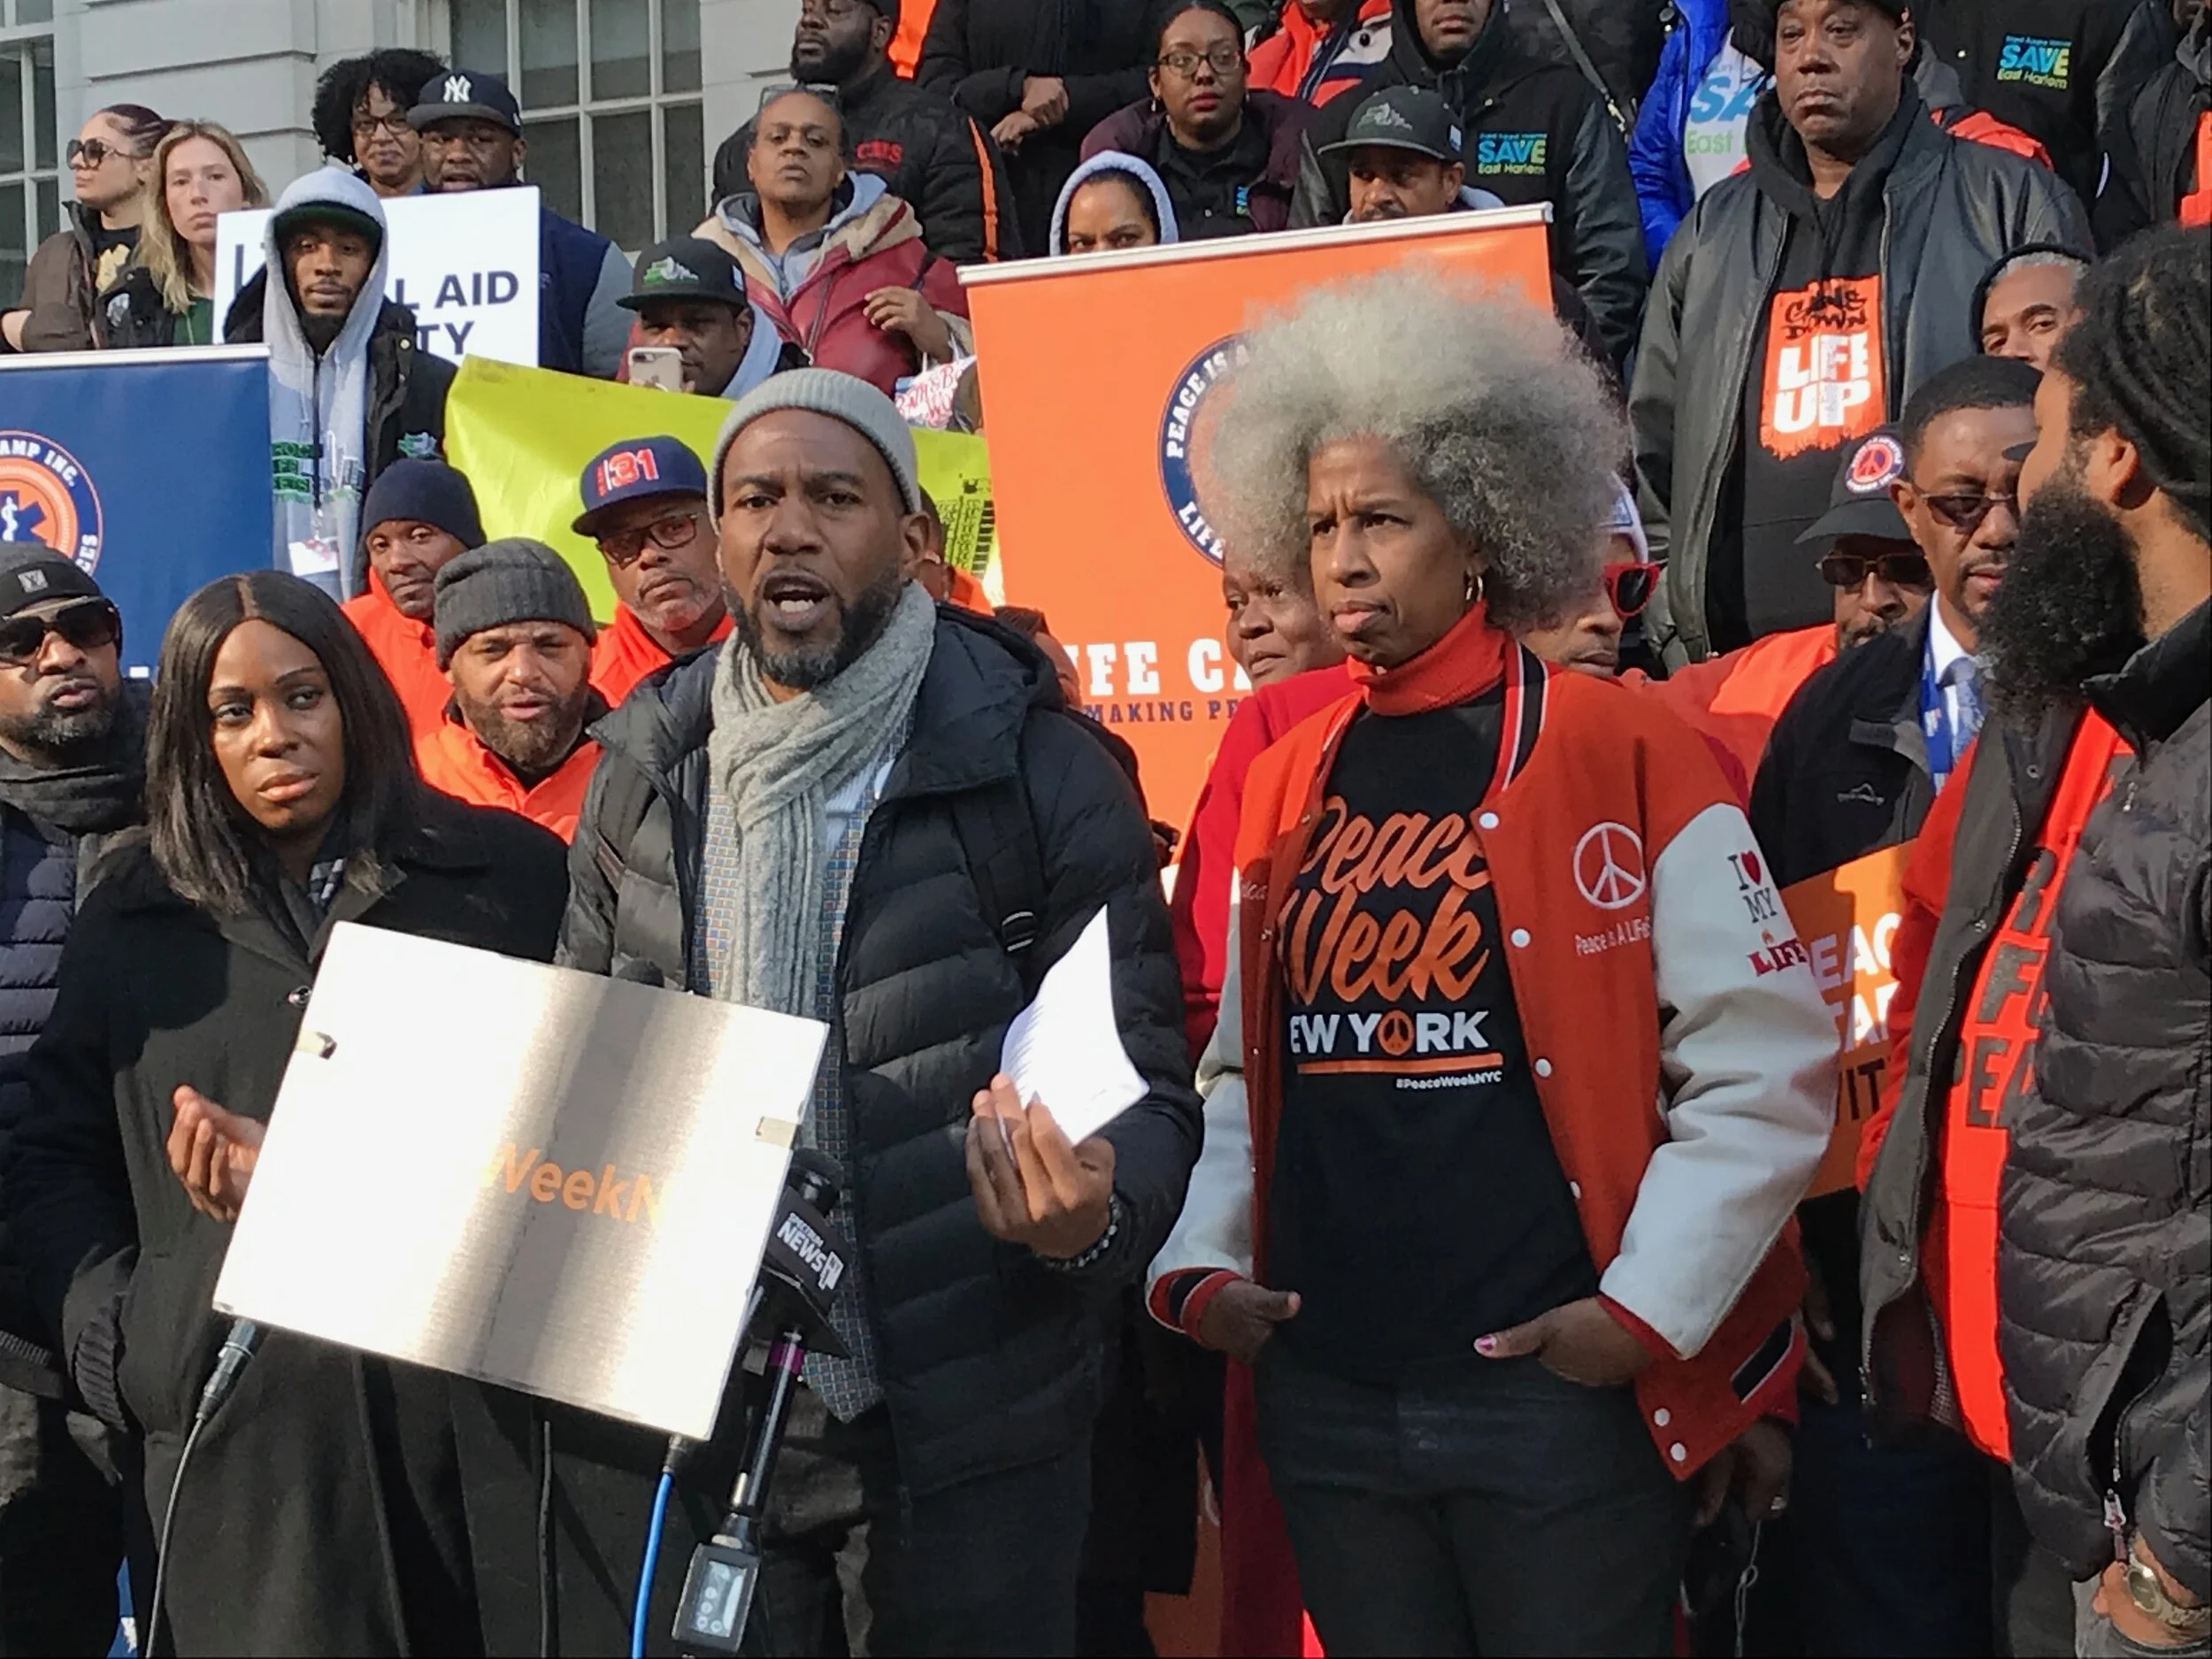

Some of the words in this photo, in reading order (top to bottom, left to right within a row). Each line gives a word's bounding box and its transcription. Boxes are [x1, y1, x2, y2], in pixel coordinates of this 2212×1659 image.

[2000, 44, 2070, 77] SAVE
[1478, 140, 1547, 165] SAVE
[1686, 130, 1733, 156] East
[434, 270, 519, 309] AID
[1778, 332, 1869, 391] LIFE
[1166, 372, 1206, 459] PEACE
[1203, 350, 1228, 379] IS
[1773, 380, 1871, 434] UP
[43, 449, 78, 488] INC.
[1178, 501, 1226, 560] LIFE
[1084, 701, 1193, 724] MAKING
[1742, 887, 1778, 924] MY
[1277, 882, 1491, 1005] Week
[1290, 1013, 1340, 1055] EW
[1395, 1070, 1503, 1090] #PeaceWeekNYC
[1837, 1058, 1886, 1124] IT
[777, 1219, 828, 1272] NEWS
